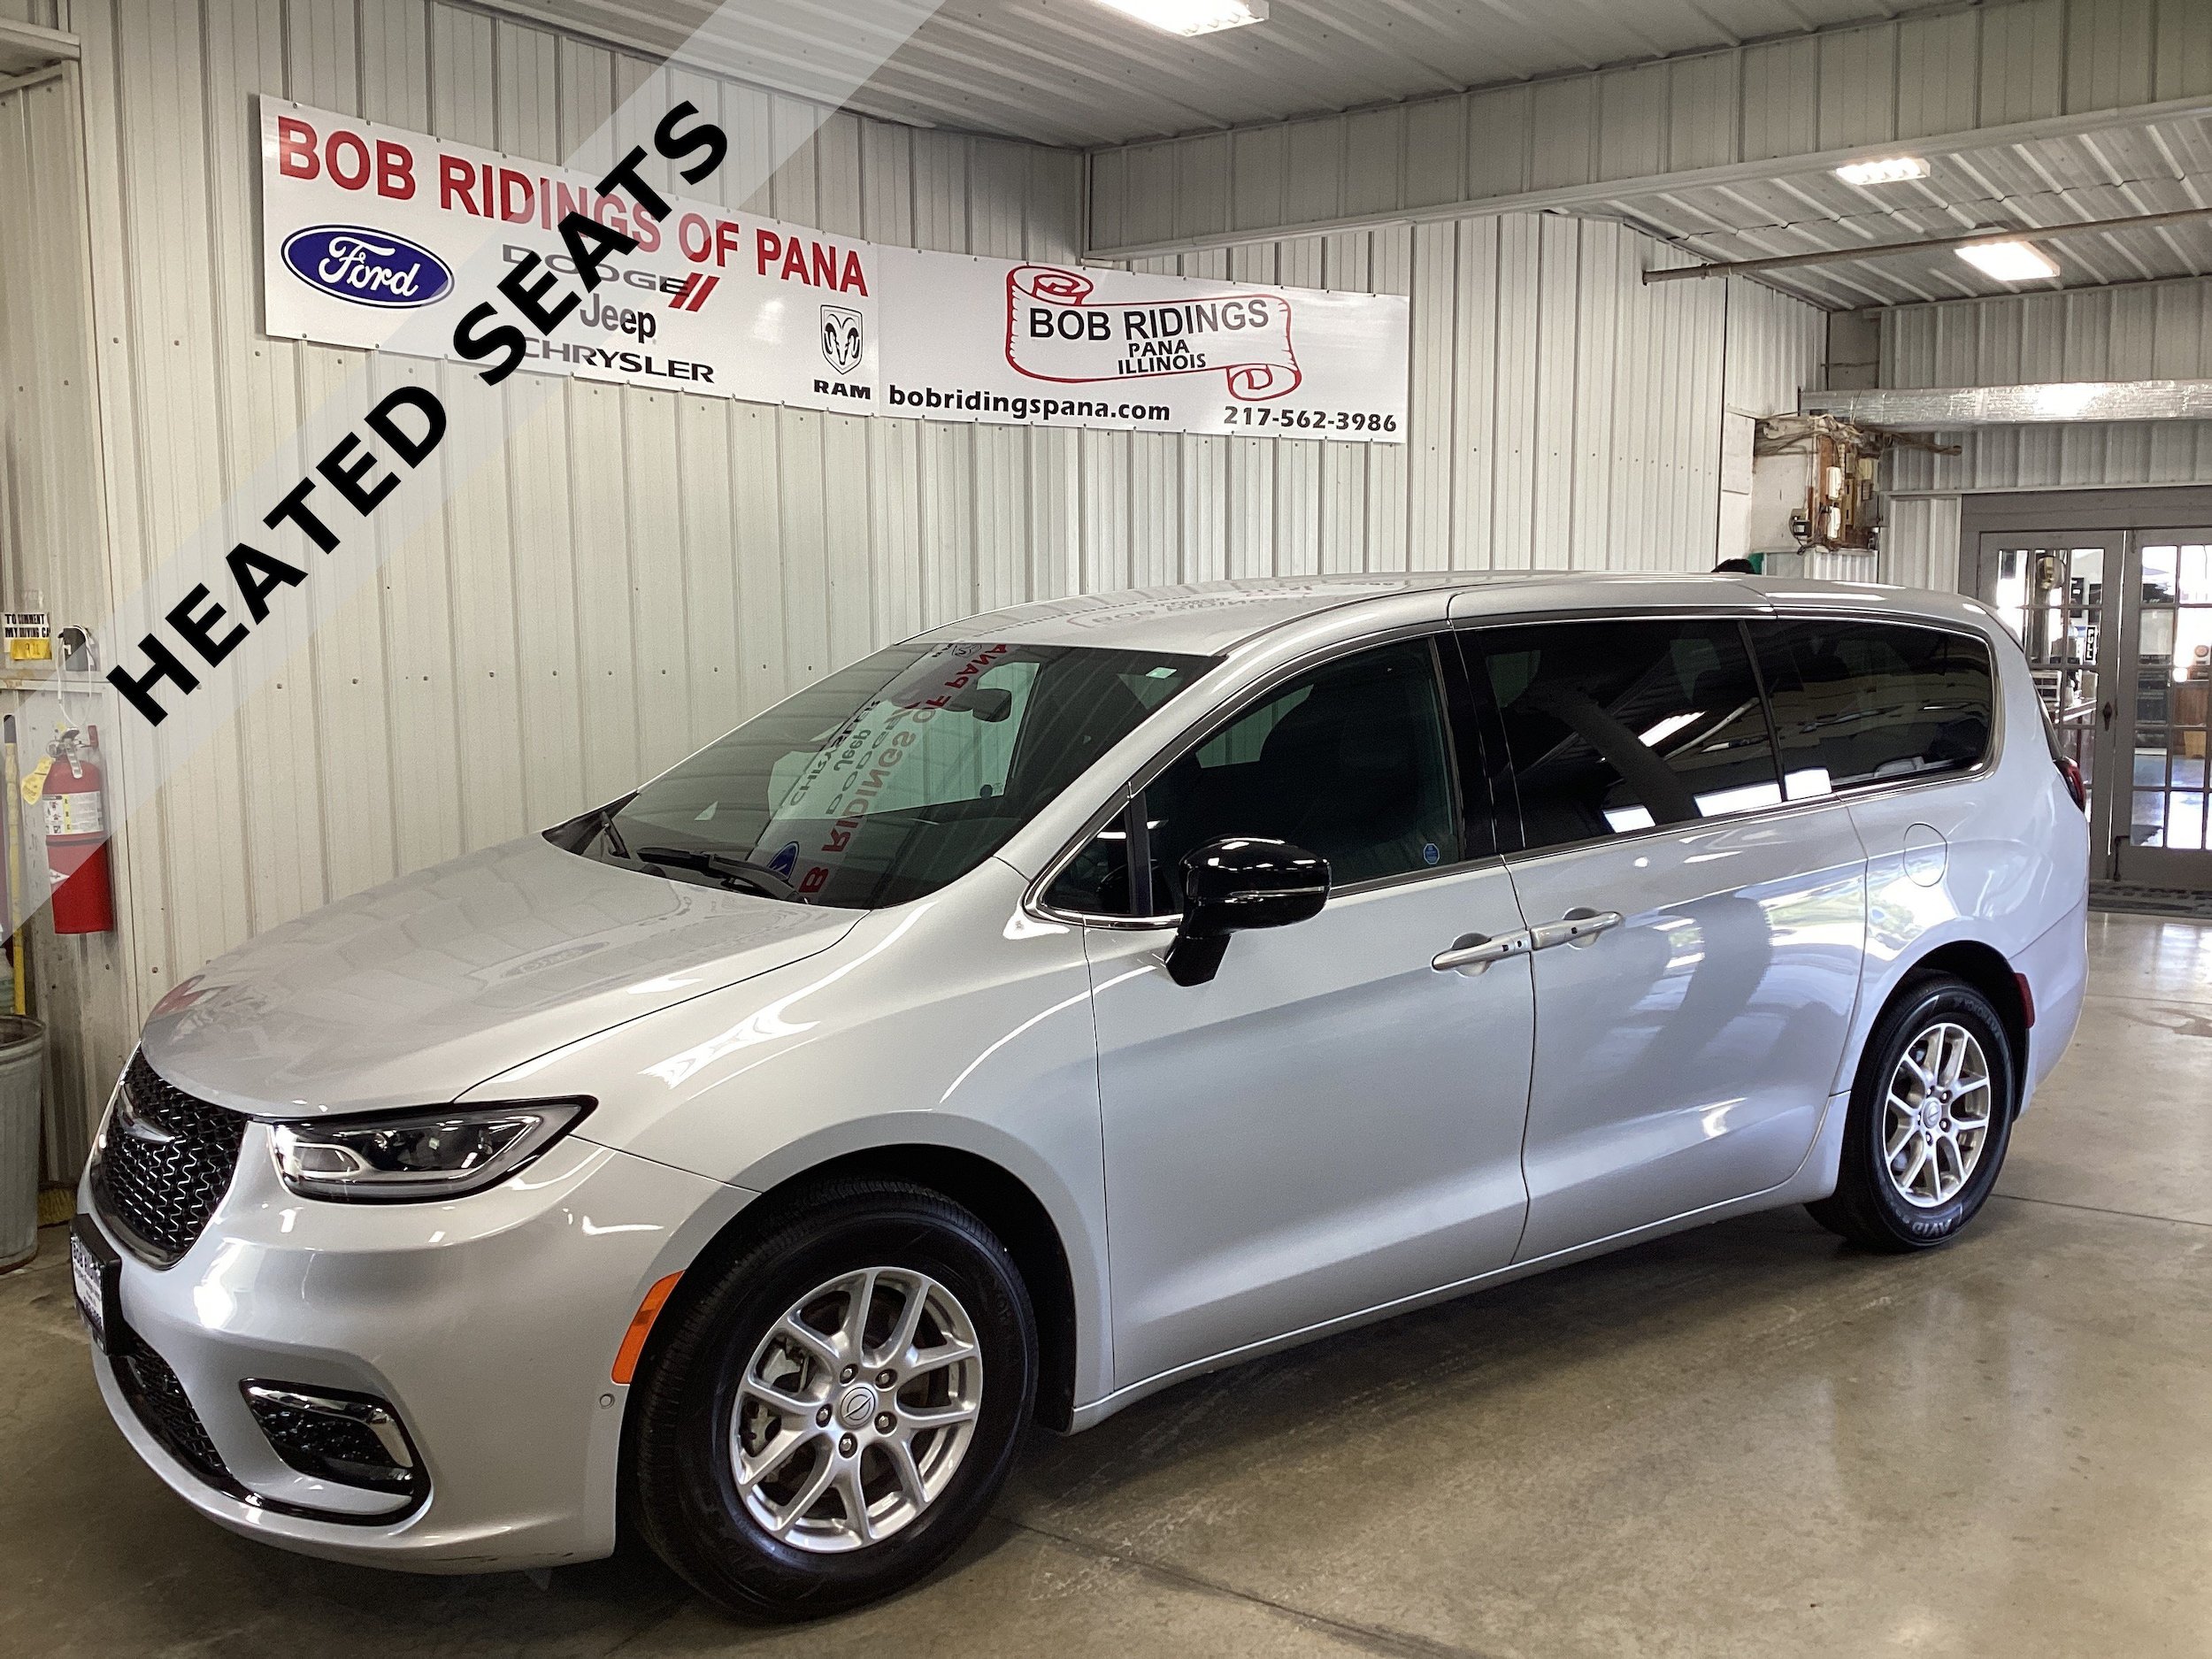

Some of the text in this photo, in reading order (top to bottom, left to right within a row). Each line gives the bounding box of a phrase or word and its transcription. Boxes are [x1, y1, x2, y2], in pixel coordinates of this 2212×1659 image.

[278, 116, 869, 297] BOB RIDINGS OF PANA
[318, 235, 419, 299] Ford
[503, 243, 690, 297] DODGE
[580, 293, 657, 343] Jeep
[1030, 298, 1269, 342] BOB RIDINGS
[523, 336, 715, 384] CHRYSLER
[1118, 353, 1207, 375] ILLINOIS
[1128, 339, 1191, 357] PANA
[813, 380, 871, 400] RAM
[889, 385, 1171, 422] bobridingspana.com
[1225, 405, 1397, 433] 217-562-3986
[4, 614, 17, 625] TO
[2085, 628, 2095, 659] PULL
